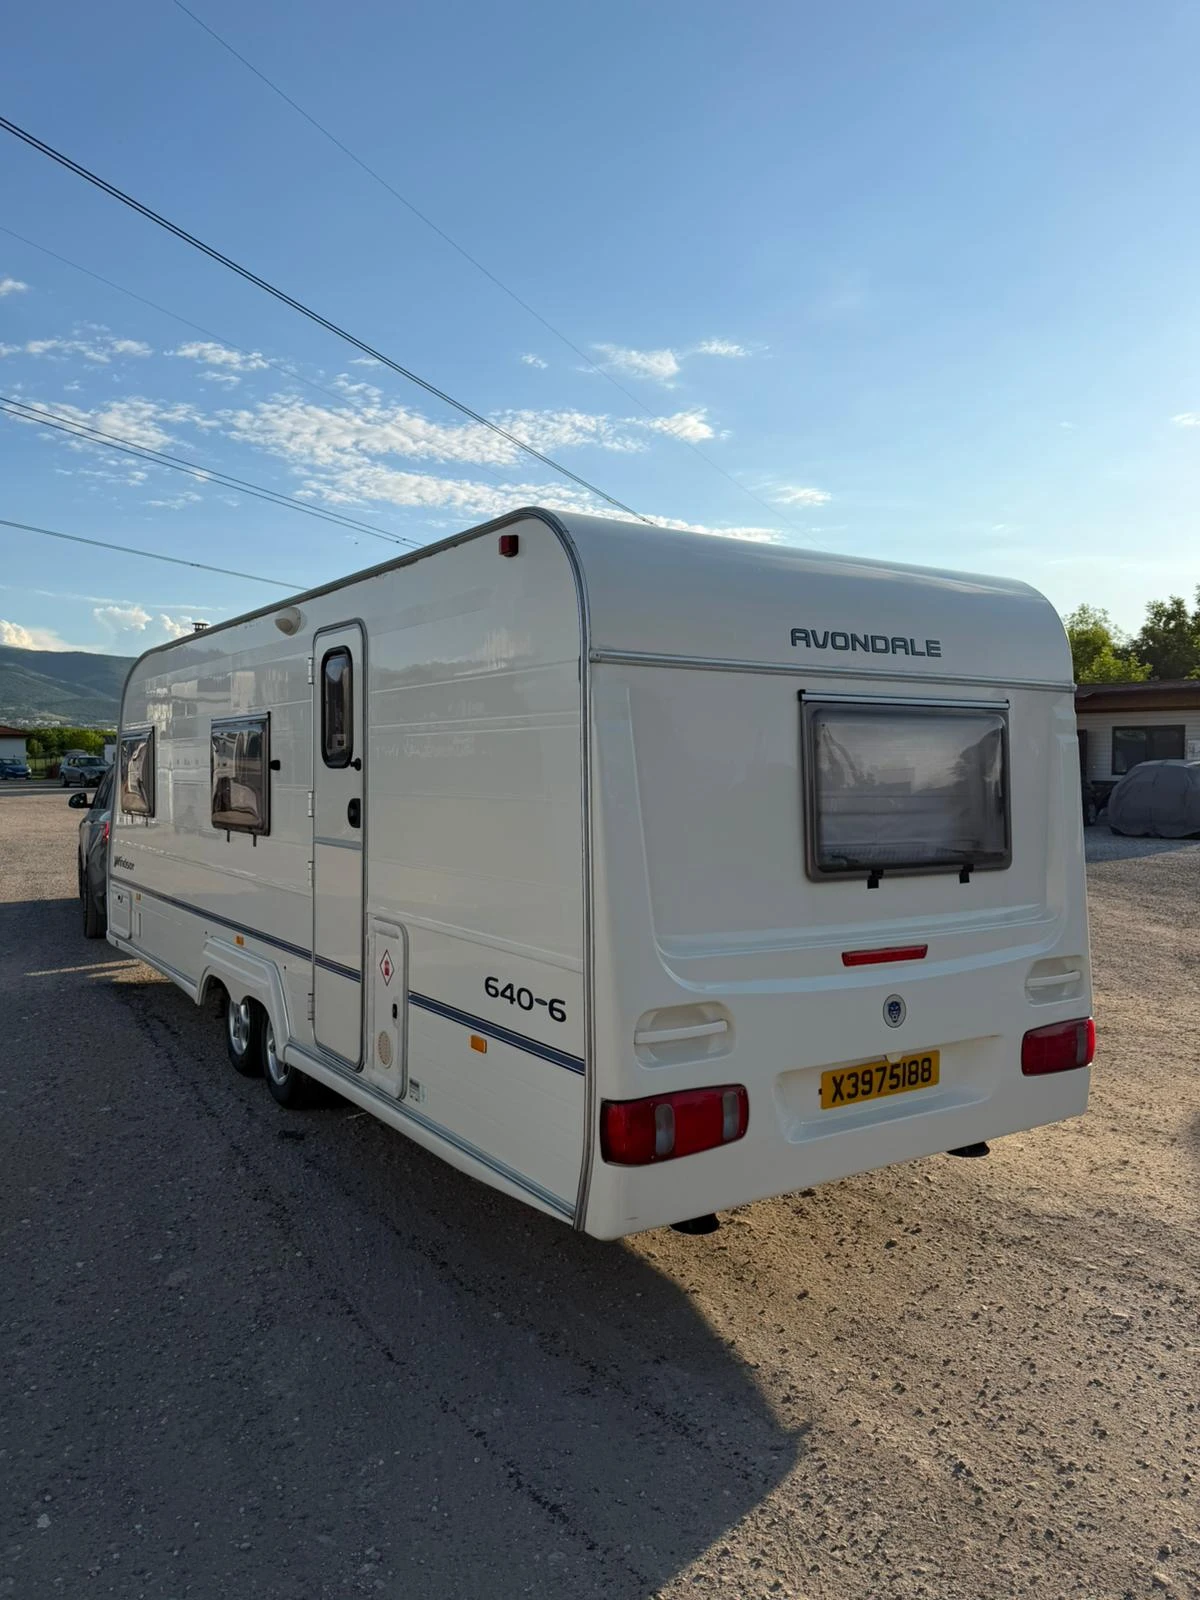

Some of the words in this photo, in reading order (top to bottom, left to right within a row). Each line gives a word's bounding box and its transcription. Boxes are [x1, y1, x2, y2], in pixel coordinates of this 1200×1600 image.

[791, 628, 942, 657] AVONDALE
[484, 976, 567, 1023] 640-6
[831, 1057, 932, 1103] X3975188
